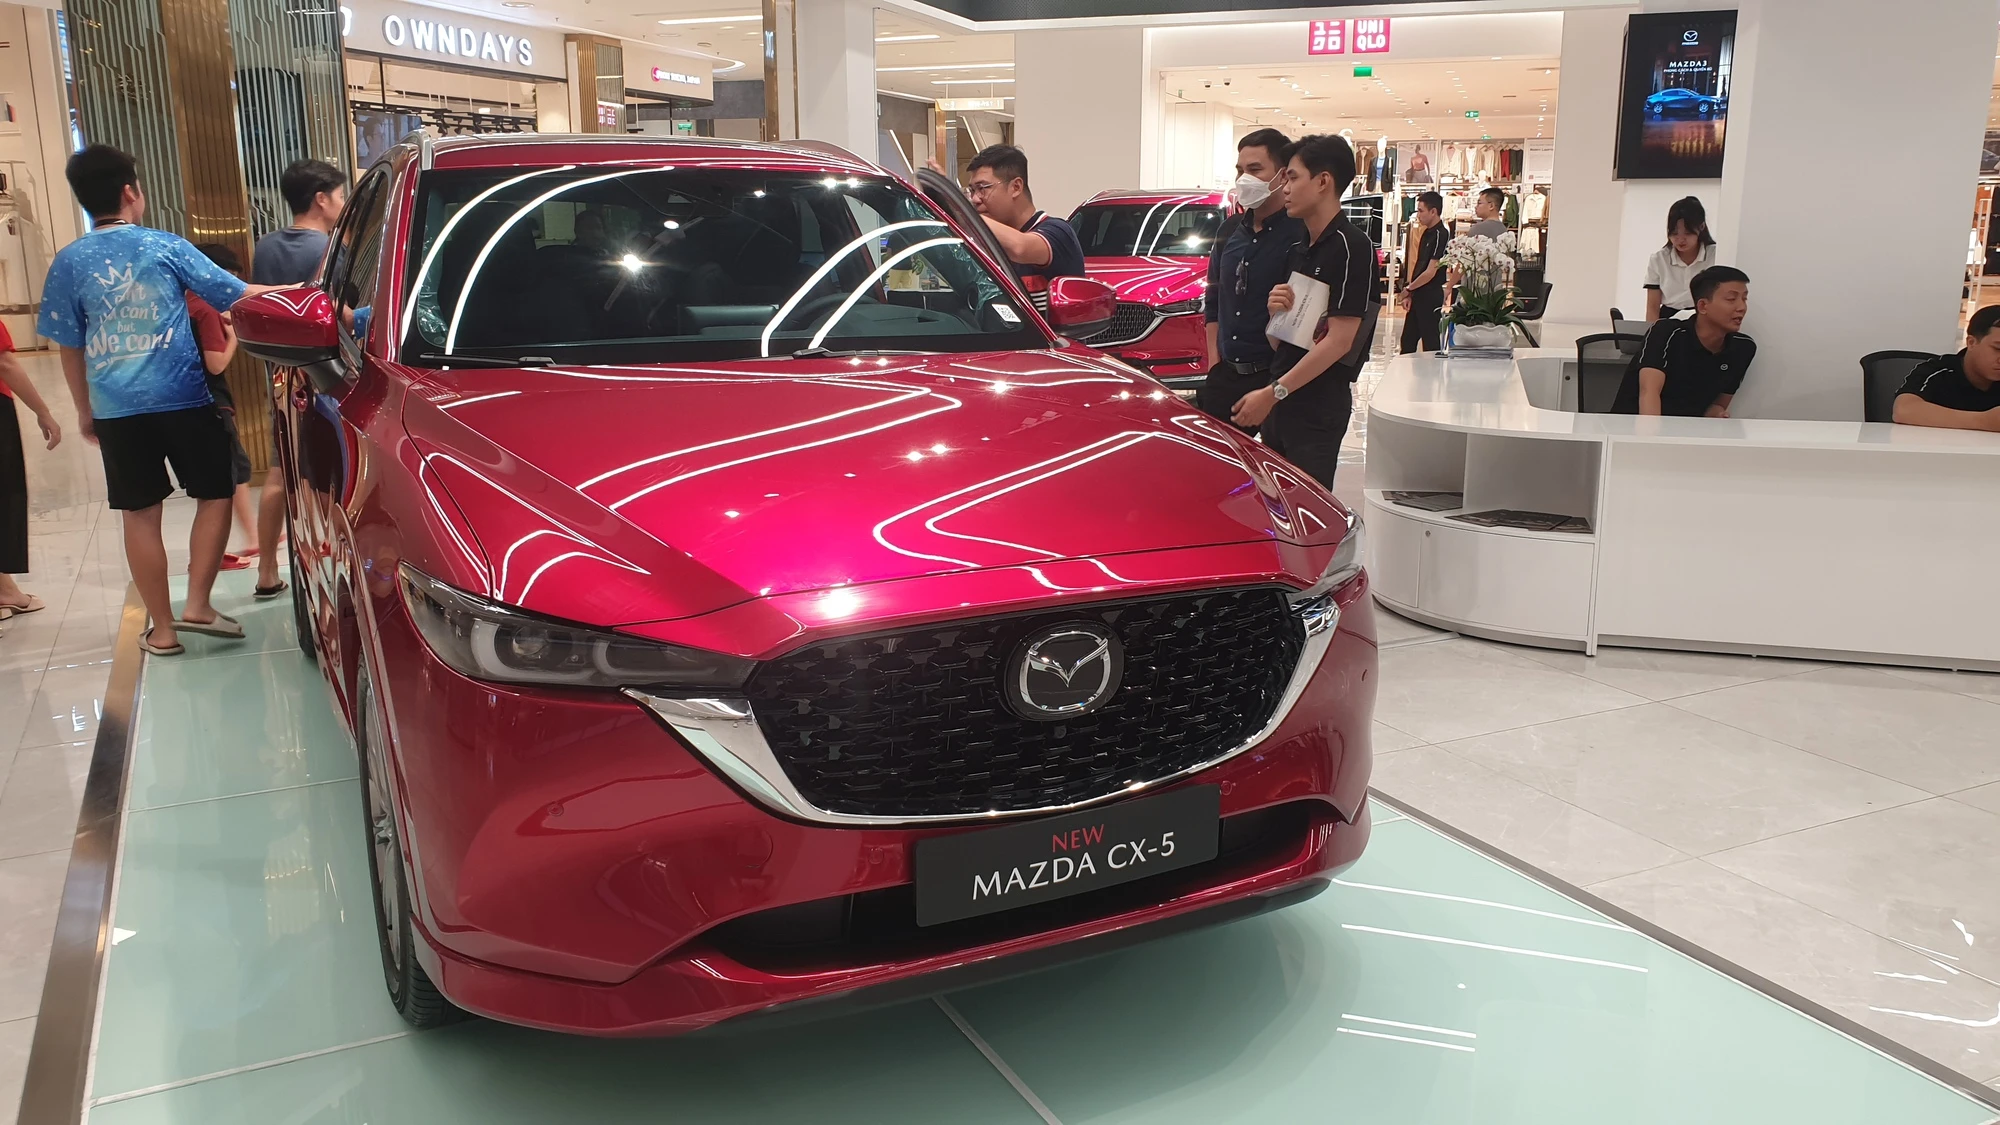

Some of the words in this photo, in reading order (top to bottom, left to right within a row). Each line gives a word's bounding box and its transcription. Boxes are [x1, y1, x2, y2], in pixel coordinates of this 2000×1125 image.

[1357, 19, 1384, 34] UNI
[384, 14, 533, 67] OWNDAYS
[1356, 34, 1386, 51] QLO
[1669, 60, 1708, 68] MAZDA3
[120, 302, 159, 320] can't
[118, 320, 137, 333] but
[87, 325, 121, 358] We
[1052, 824, 1105, 853] NEW
[972, 852, 1097, 900] MAZDA
[1107, 832, 1175, 869] CX-5
